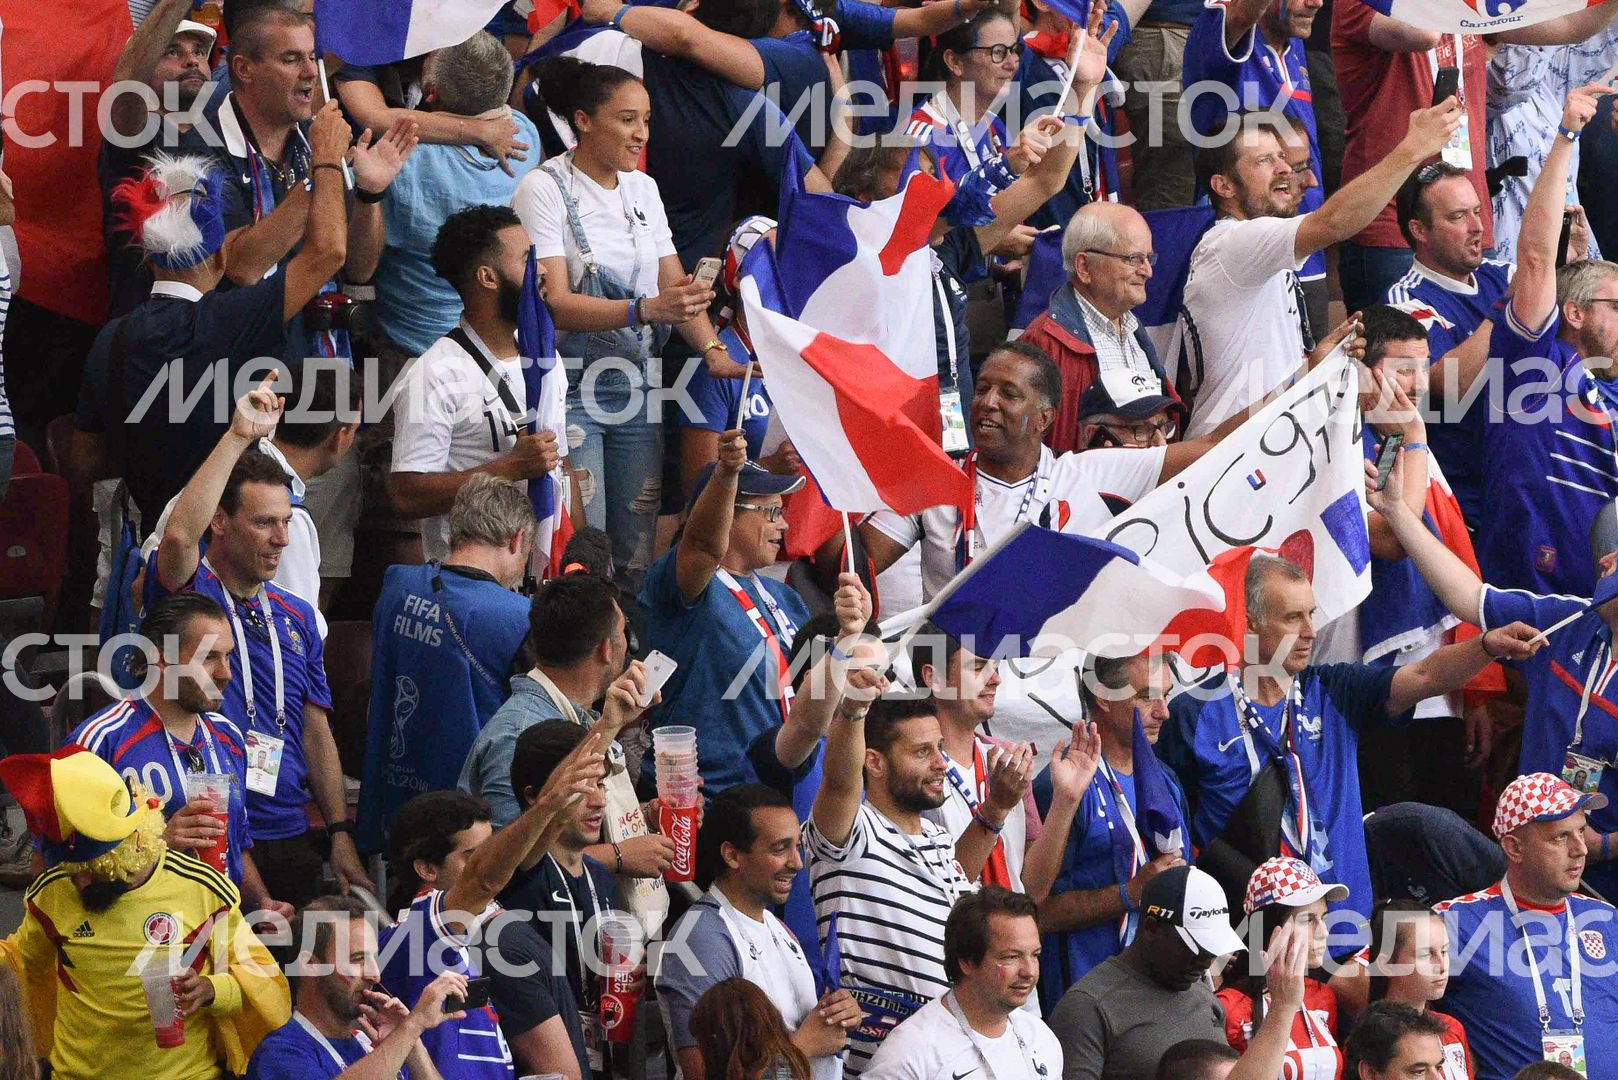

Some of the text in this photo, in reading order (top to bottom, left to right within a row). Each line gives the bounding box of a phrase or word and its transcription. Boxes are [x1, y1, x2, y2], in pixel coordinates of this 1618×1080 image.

[1459, 14, 1524, 29] Carrefour
[403, 593, 441, 624] FIFA
[393, 614, 444, 648] FILMS
